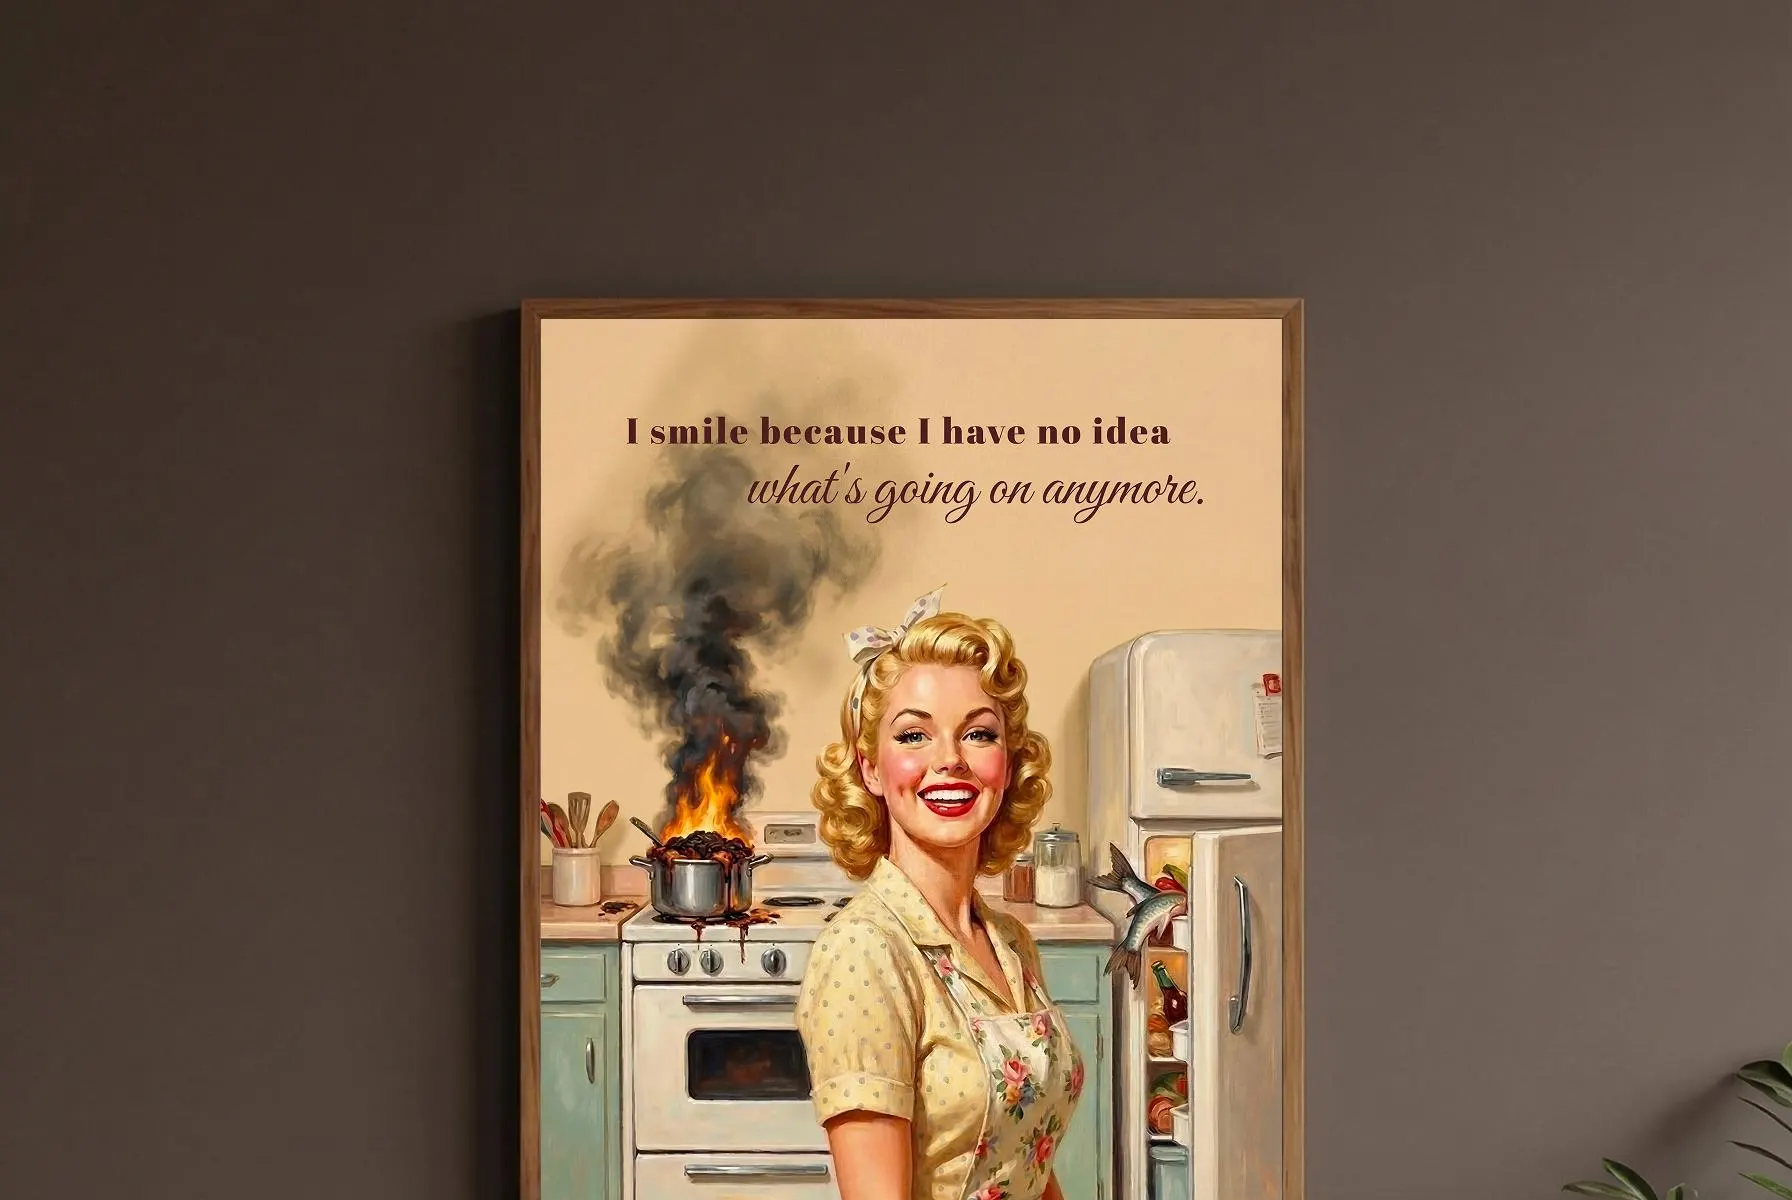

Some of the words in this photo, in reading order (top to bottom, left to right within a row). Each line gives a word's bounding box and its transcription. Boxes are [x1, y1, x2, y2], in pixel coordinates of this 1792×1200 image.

[626, 417, 639, 445] I
[650, 416, 749, 445] smile
[759, 416, 907, 445] because
[918, 417, 930, 445] I
[942, 416, 1026, 445] have
[1037, 425, 1082, 445] no
[1092, 416, 1172, 445] idea
[747, 462, 867, 504] what's
[866, 472, 982, 524] going
[989, 480, 1036, 505] on
[1042, 474, 1204, 524] anymore.
